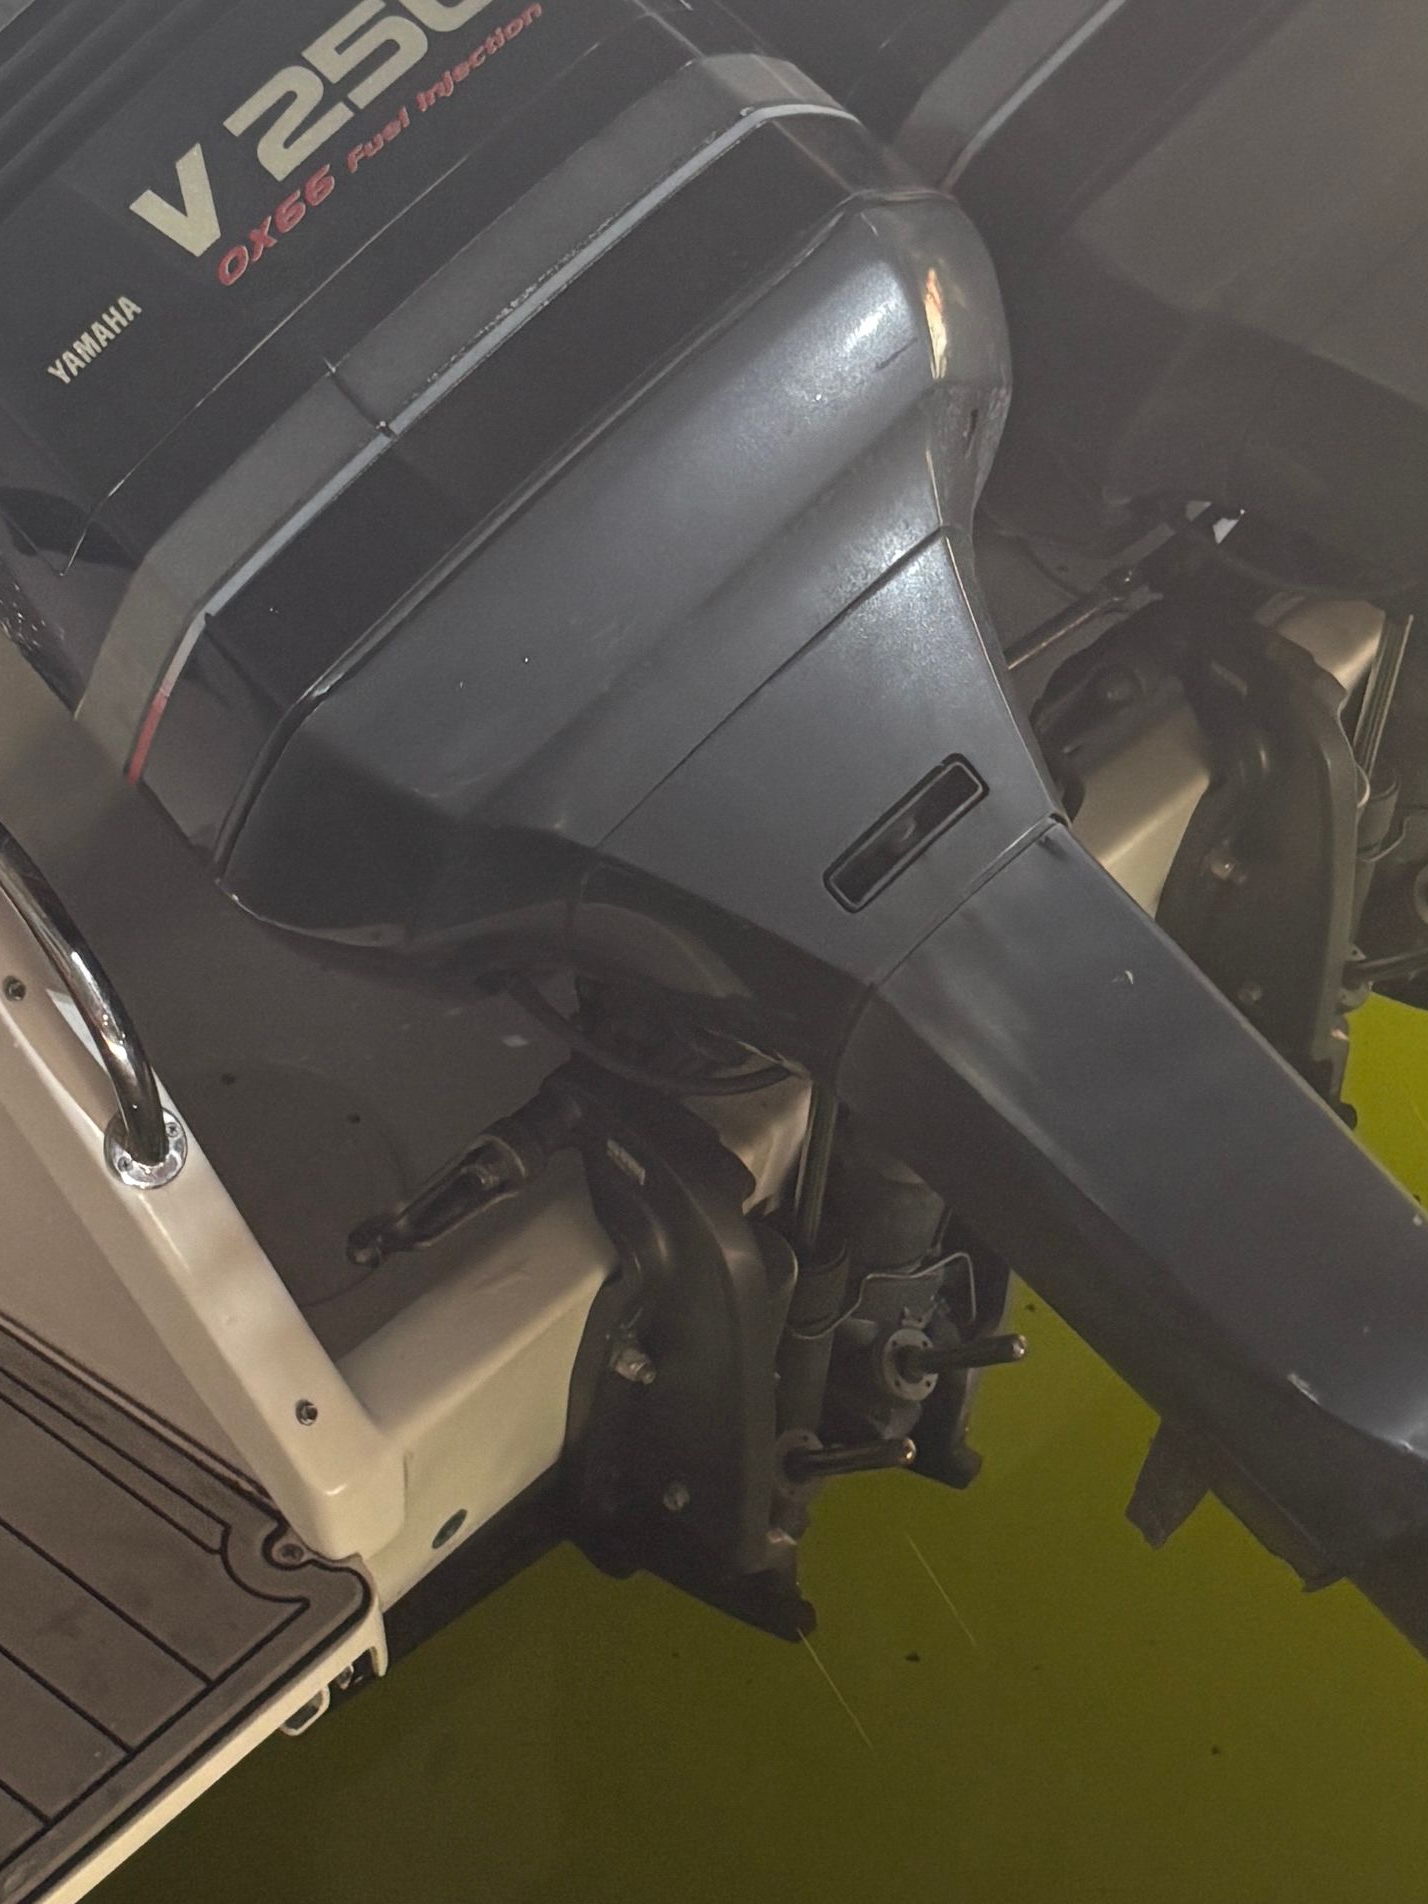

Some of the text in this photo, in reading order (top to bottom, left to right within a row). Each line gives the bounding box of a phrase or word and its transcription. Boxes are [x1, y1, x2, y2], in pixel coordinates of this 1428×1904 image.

[129, 141, 221, 257] V
[217, 3, 543, 286] OX66 Fuel Injection
[47, 295, 143, 384] YAMAHA
